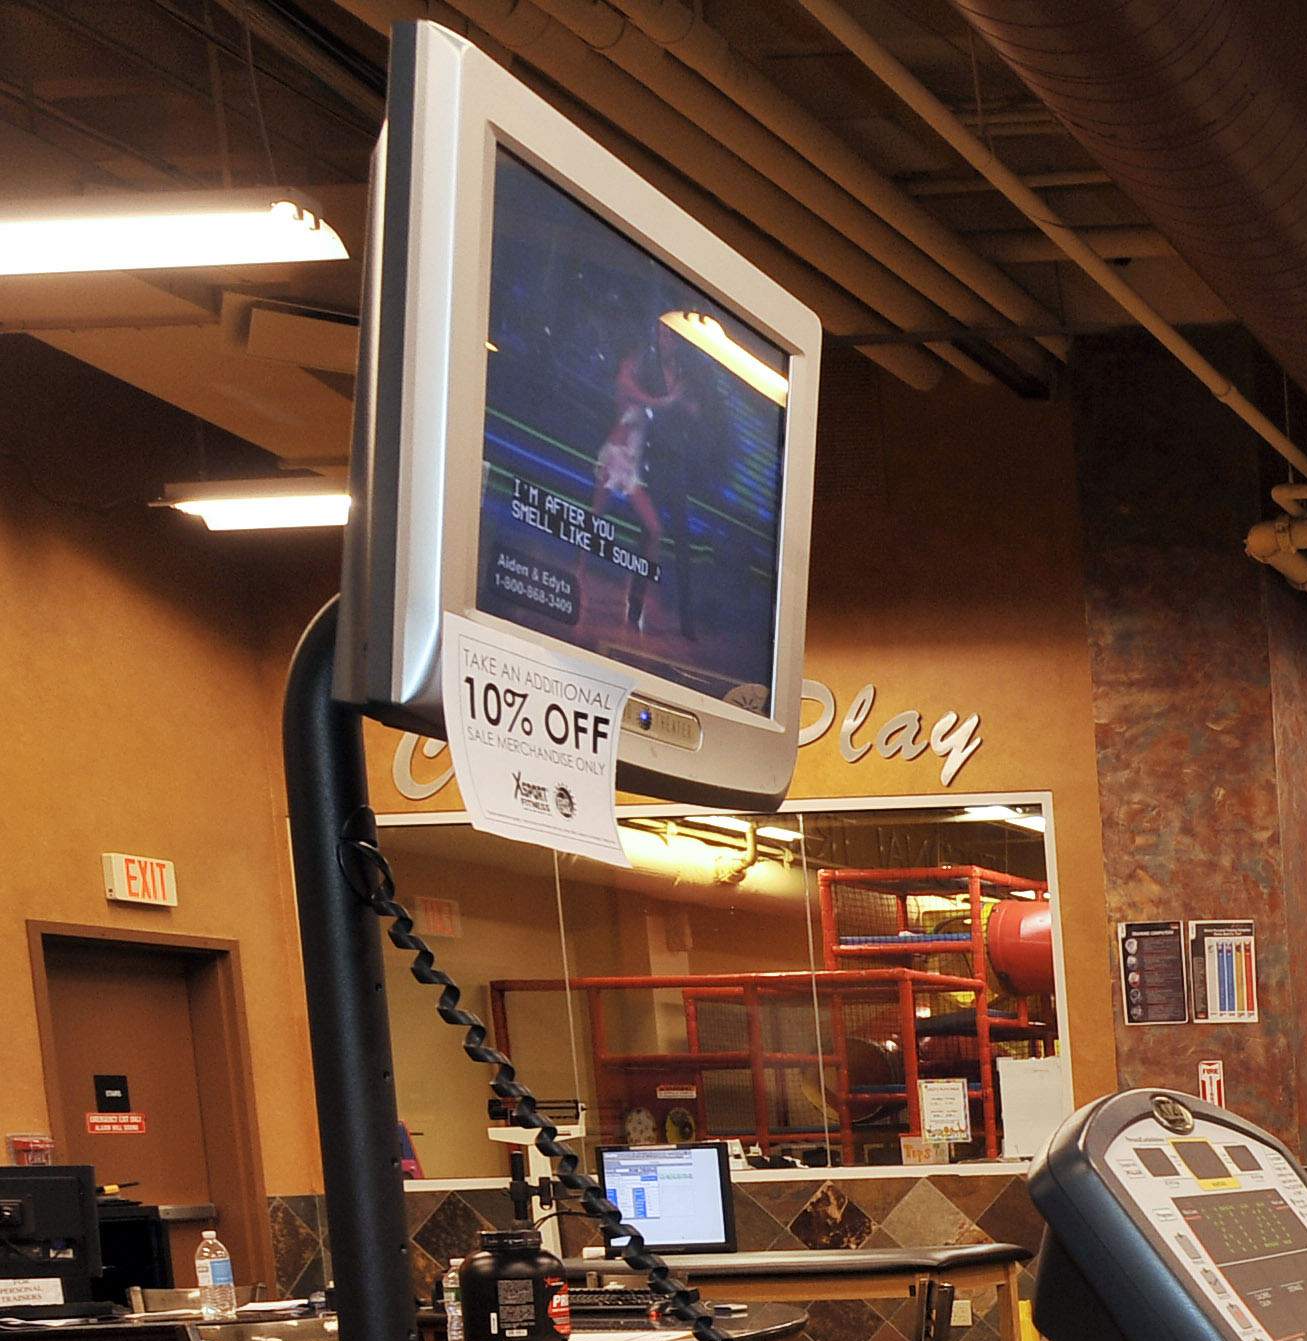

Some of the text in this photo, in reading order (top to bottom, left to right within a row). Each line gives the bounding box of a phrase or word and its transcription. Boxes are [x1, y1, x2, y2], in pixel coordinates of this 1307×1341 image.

[511, 500, 648, 576] SMELL LIKE I SOUND
[515, 478, 615, 541] I'M AFTER YOU
[497, 553, 528, 576] Aiden
[542, 570, 571, 595] Edyta
[463, 649, 497, 675] TAKE
[501, 665, 521, 684] AN
[525, 671, 612, 710] ADDITIONAL
[464, 676, 533, 737] 10%
[544, 703, 611, 754] OFF
[467, 726, 606, 776] SALE MERCHANDISE ONLY
[124, 858, 167, 901] EXIT
